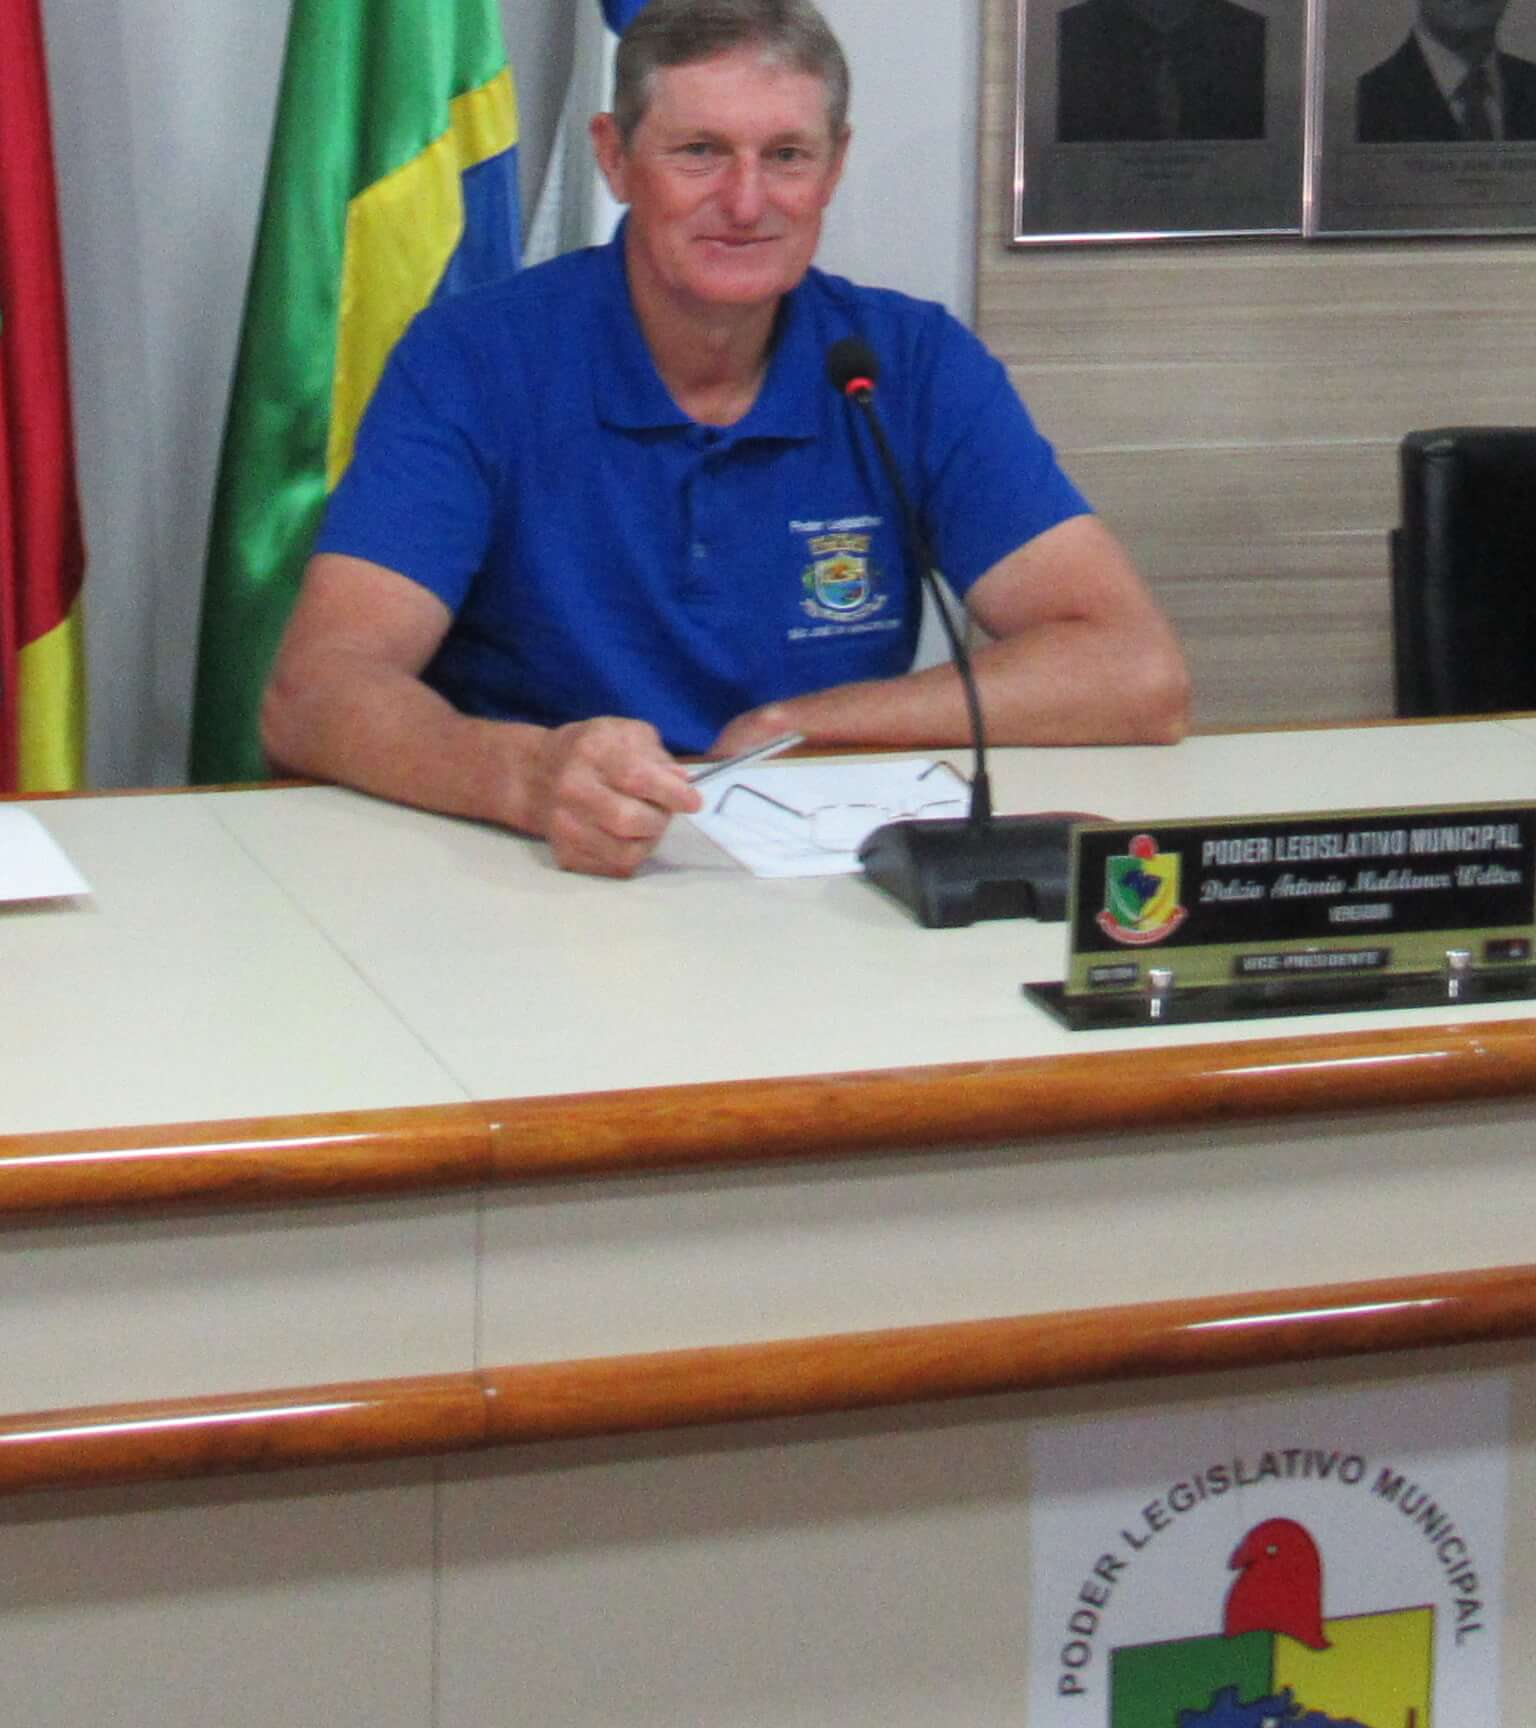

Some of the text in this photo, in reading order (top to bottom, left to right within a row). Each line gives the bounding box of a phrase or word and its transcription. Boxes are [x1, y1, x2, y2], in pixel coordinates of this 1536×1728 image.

[1201, 823, 1522, 867] PODER LEGISLATIVO MUNICIPAL
[1057, 1447, 1486, 1697] PODER LEGISLATIVO MUNICIPAL
